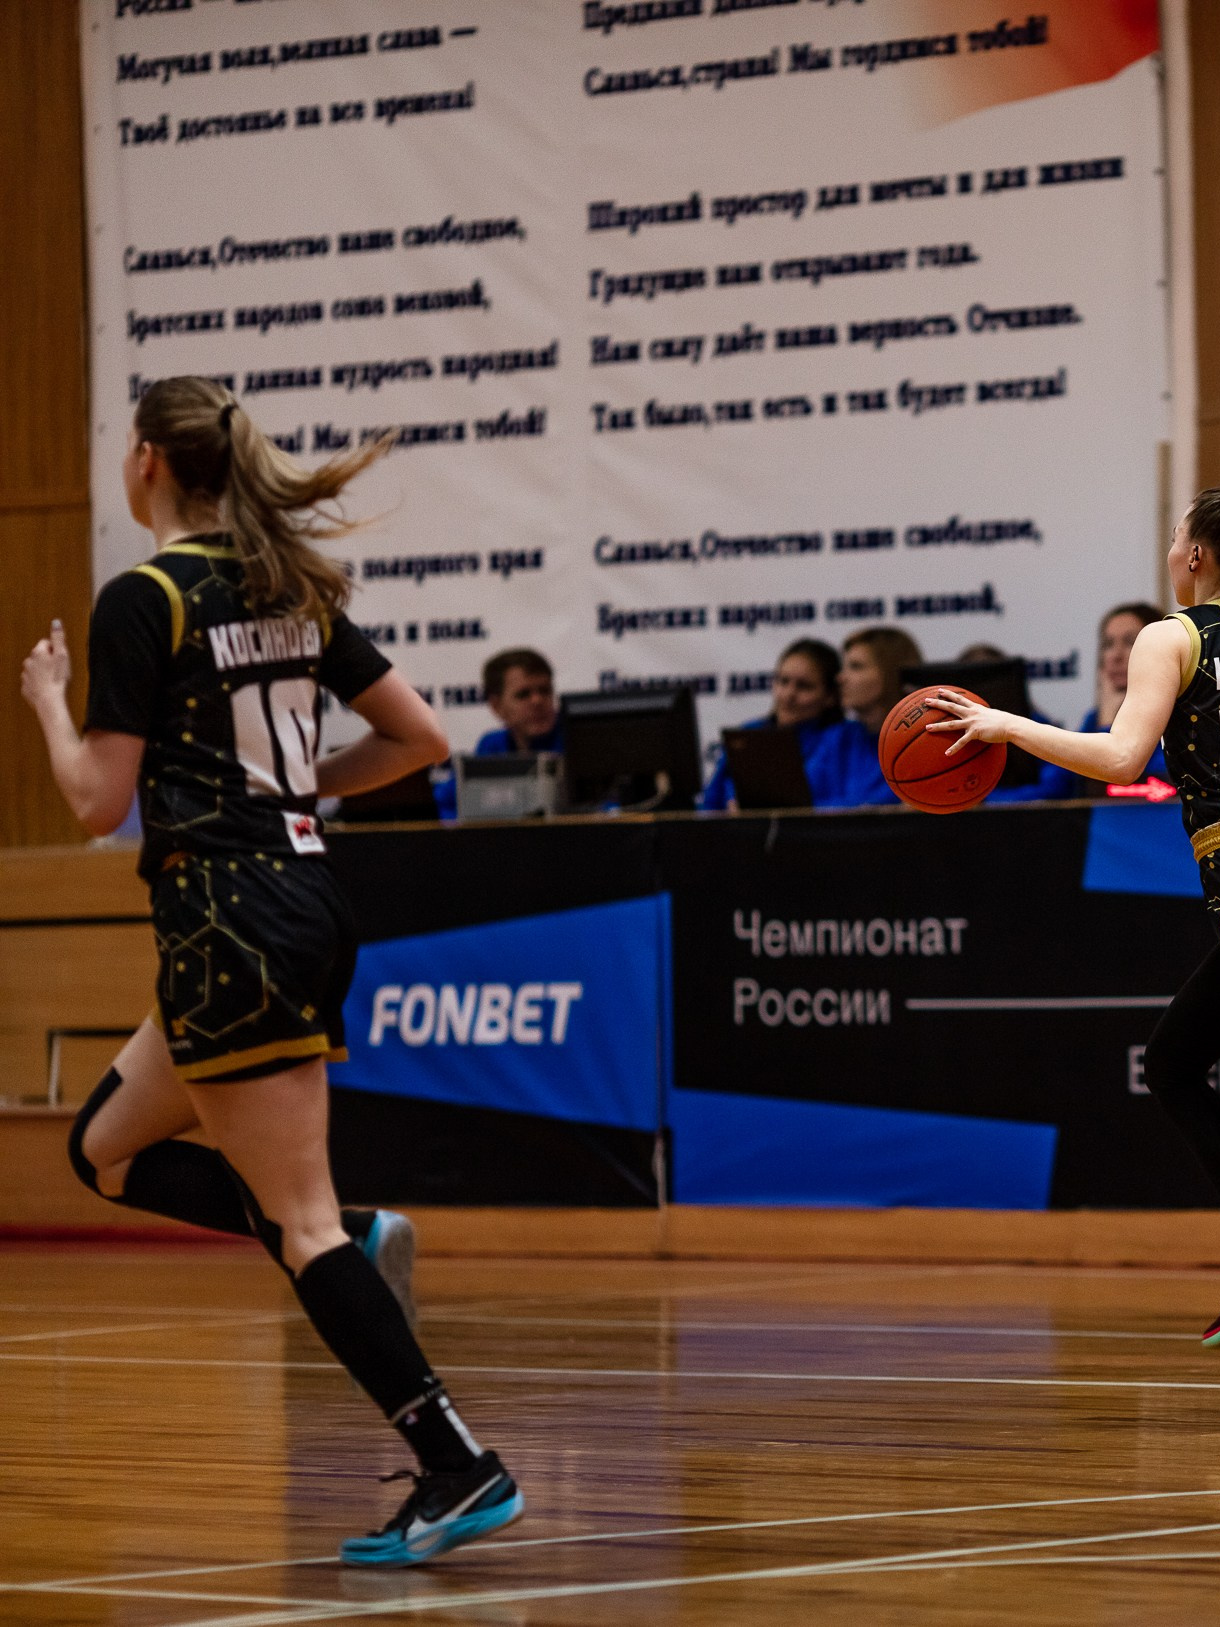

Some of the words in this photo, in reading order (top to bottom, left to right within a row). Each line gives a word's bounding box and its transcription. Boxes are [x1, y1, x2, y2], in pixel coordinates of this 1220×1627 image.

[734, 910, 968, 957] Чемпионат
[368, 982, 583, 1046] FONBET
[734, 978, 891, 1026] России
